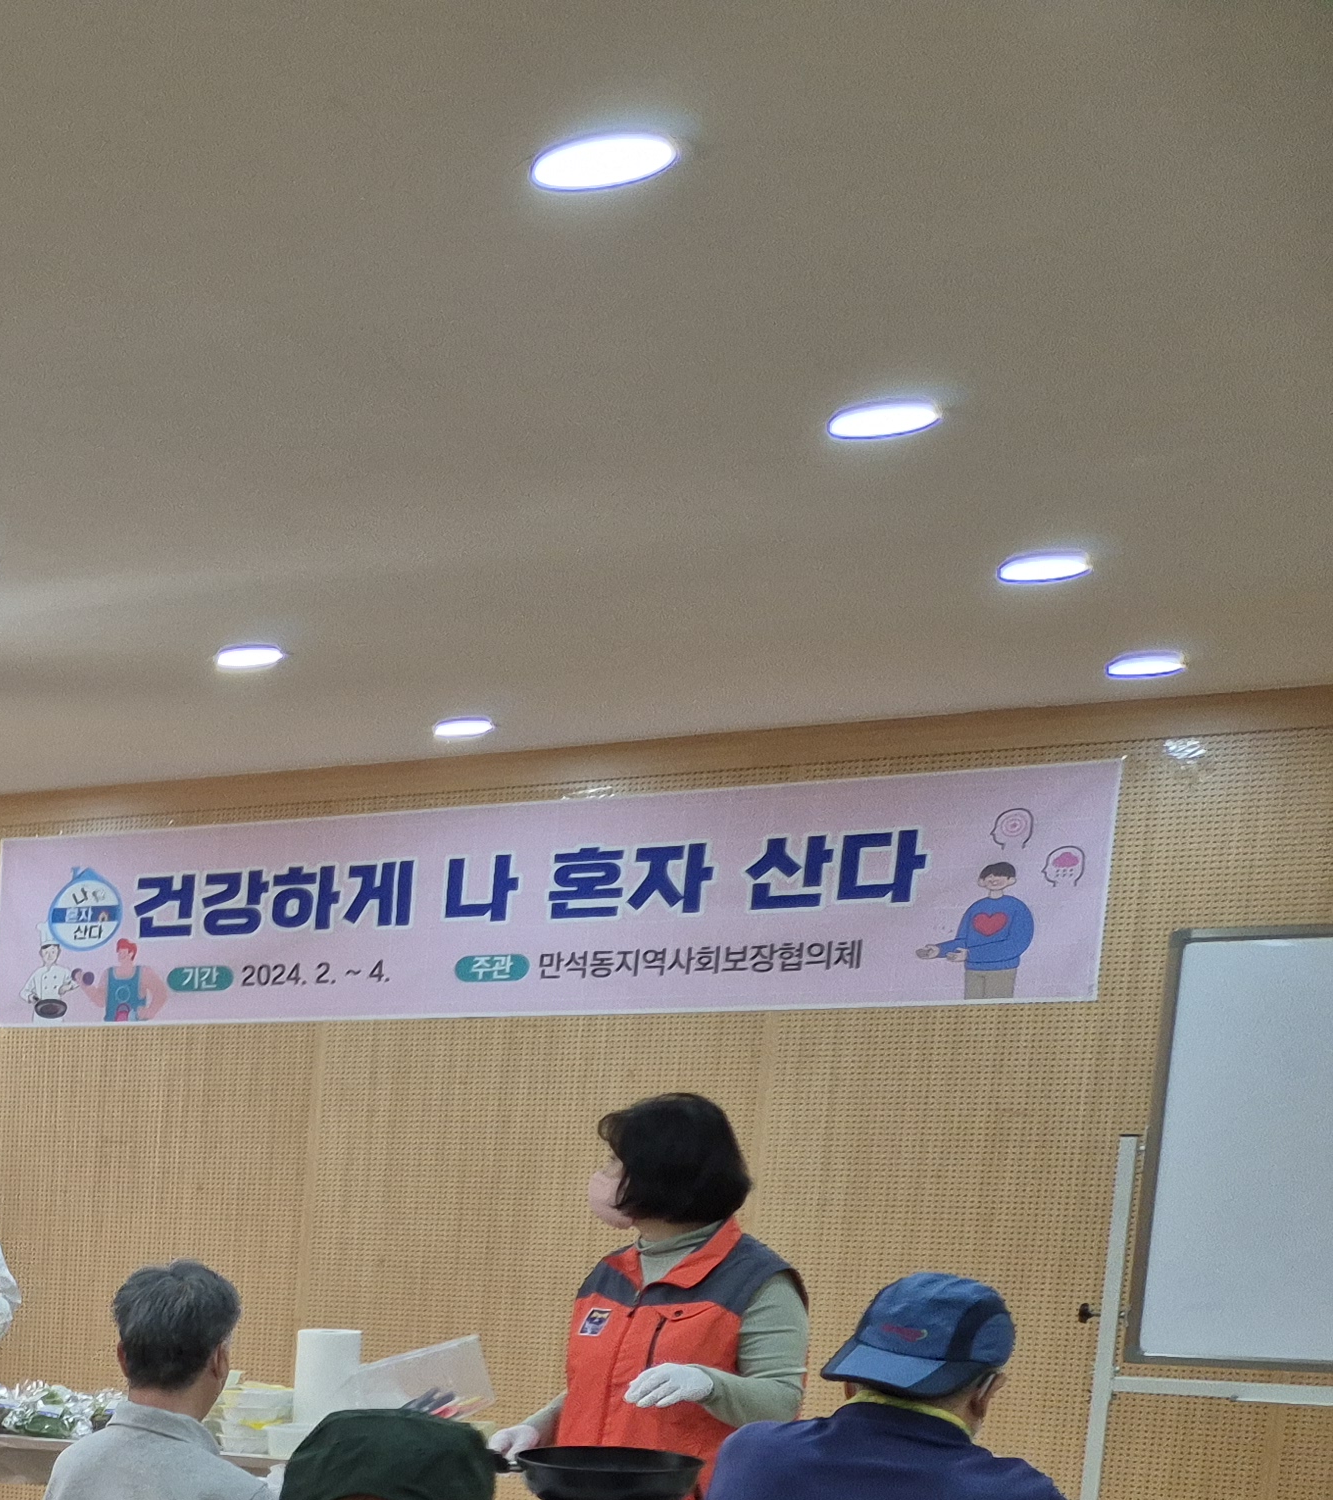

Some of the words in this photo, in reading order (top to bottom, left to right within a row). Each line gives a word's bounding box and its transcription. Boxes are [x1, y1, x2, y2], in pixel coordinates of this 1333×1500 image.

[72, 887, 89, 905] 나
[133, 860, 415, 938] 건강하게
[444, 854, 519, 922] 나
[547, 842, 714, 920] 혼자
[745, 829, 928, 911] 산다
[73, 924, 103, 940] 산다
[182, 966, 219, 990] 기간
[241, 962, 307, 987] 2024.
[315, 961, 336, 985] 2.
[368, 959, 390, 983] 4.
[470, 955, 514, 980] 주관
[539, 939, 863, 980] 만석동지역사회보장협의체
